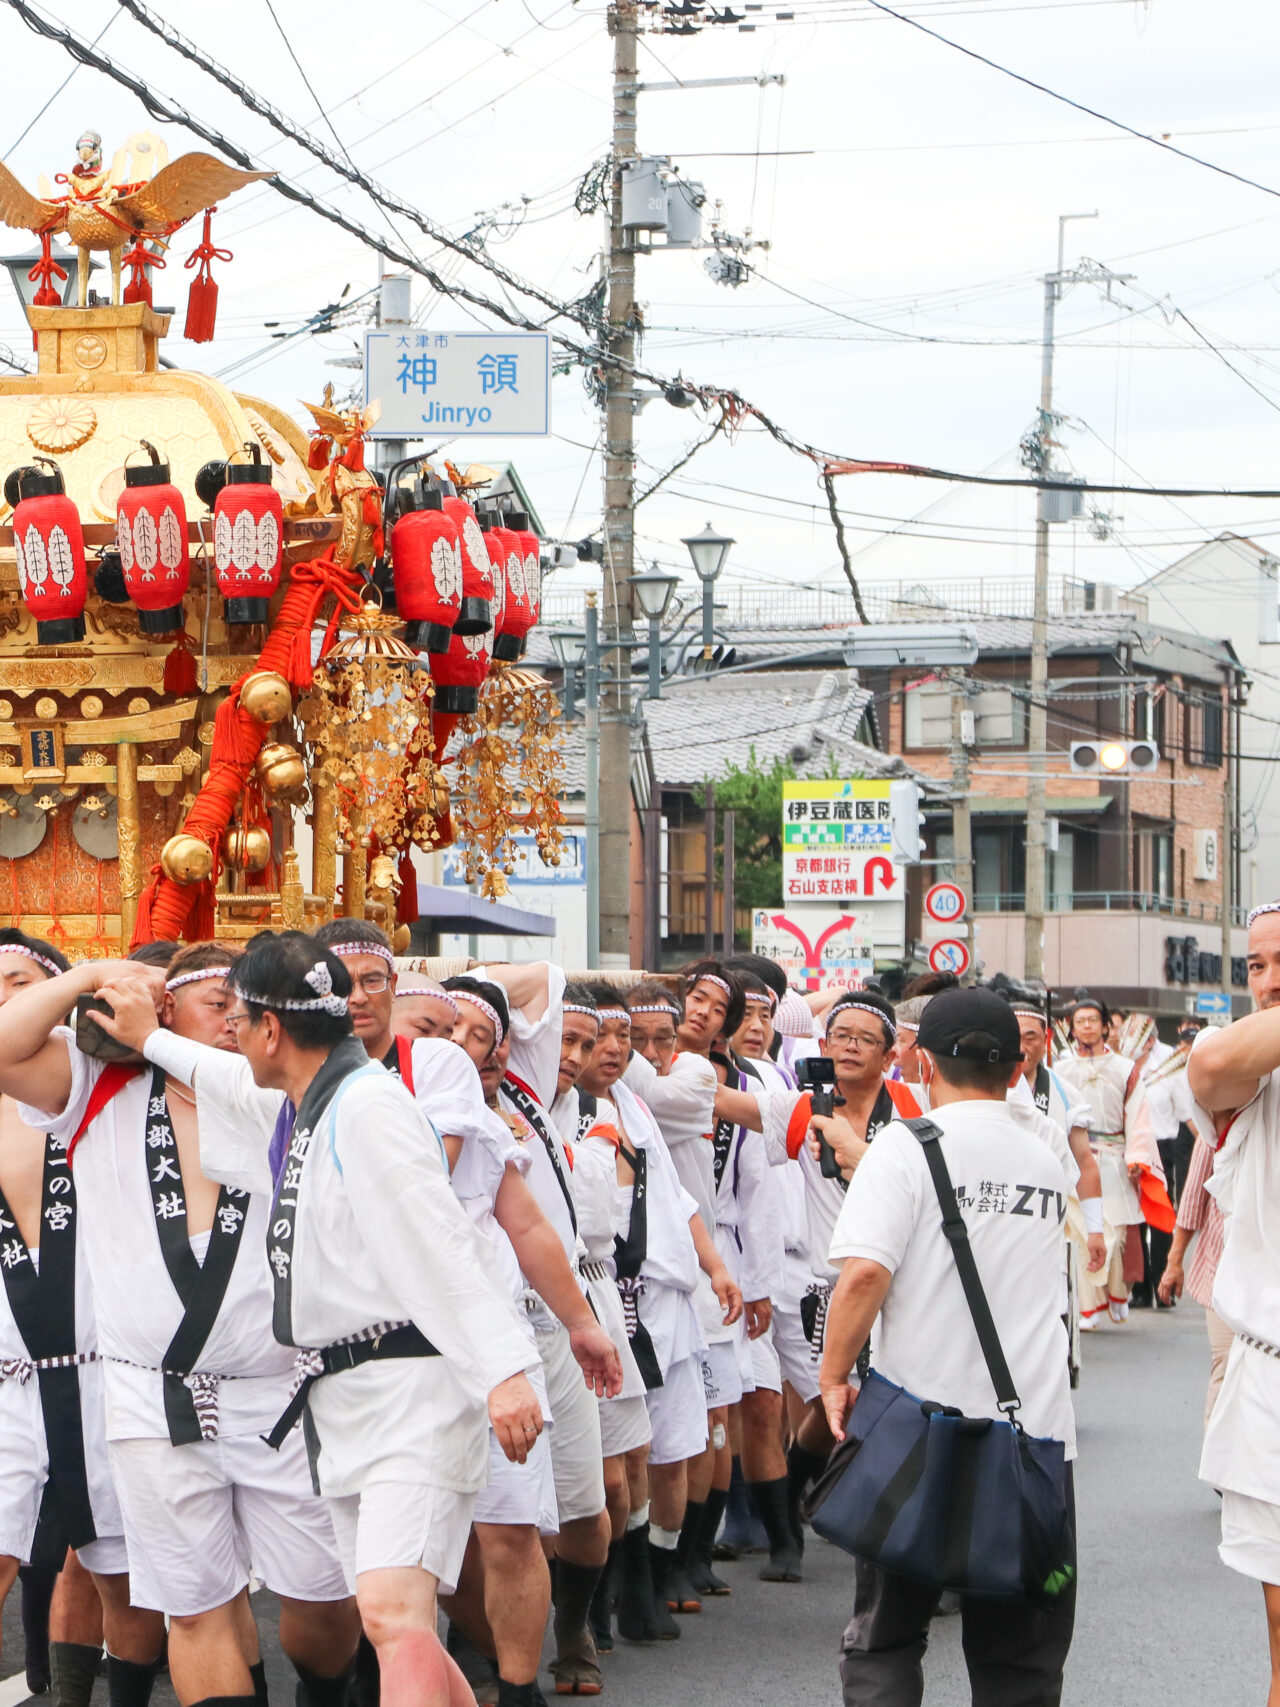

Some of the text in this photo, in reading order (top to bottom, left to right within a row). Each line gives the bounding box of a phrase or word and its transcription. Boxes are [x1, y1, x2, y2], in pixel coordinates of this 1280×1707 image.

[648, 198, 662, 210] 20
[396, 334, 448, 349] 大津市
[396, 353, 519, 394] 神領
[422, 401, 492, 427] Jinryo
[795, 858, 850, 873] 京都銀行
[788, 879, 858, 895] 石山支店横
[935, 895, 957, 912] 40
[823, 946, 871, 959] ゼン工業
[827, 979, 863, 992] 680
[146, 1093, 187, 1220] 建部大社
[979, 1180, 1009, 1197] 株式
[270, 1127, 312, 1280] 近江一の宮
[977, 1196, 1007, 1213] 会社
[1010, 1184, 1067, 1225] ZTV
